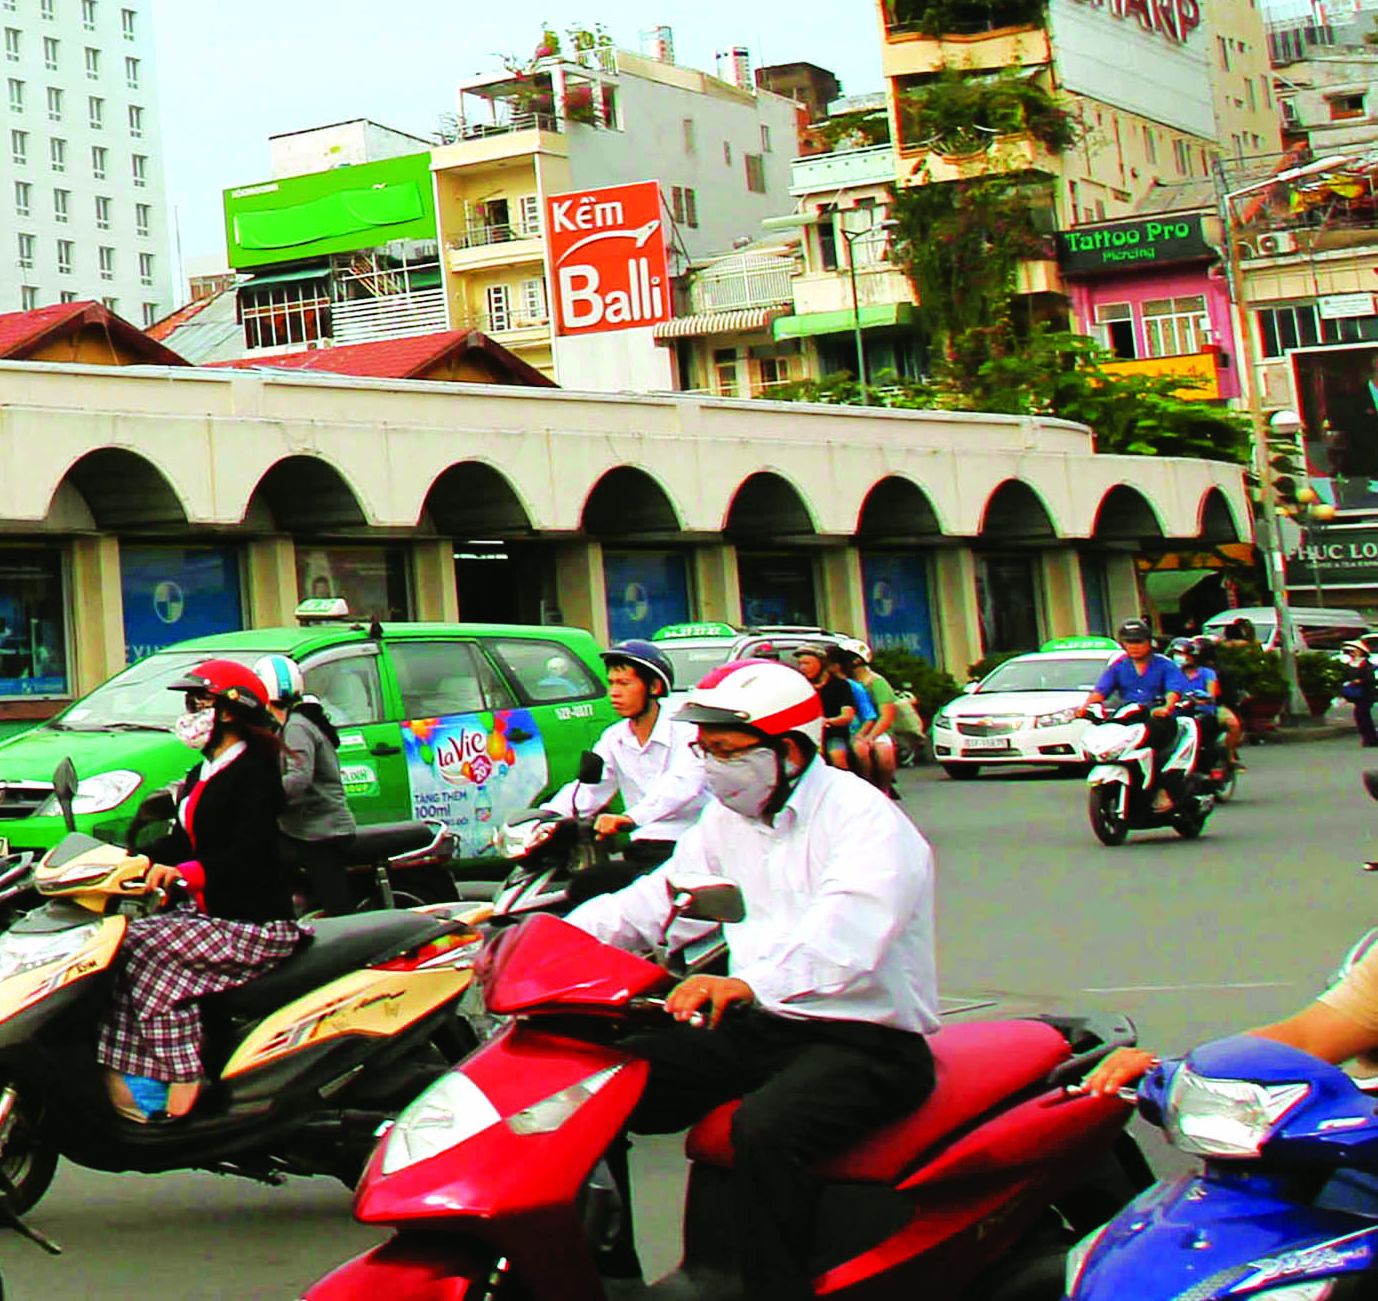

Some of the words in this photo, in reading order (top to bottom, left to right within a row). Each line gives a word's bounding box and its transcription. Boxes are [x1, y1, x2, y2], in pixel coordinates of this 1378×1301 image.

[1065, 229, 1140, 252] Tattoo
[1146, 222, 1189, 242] Pro
[559, 257, 663, 328] Balli
